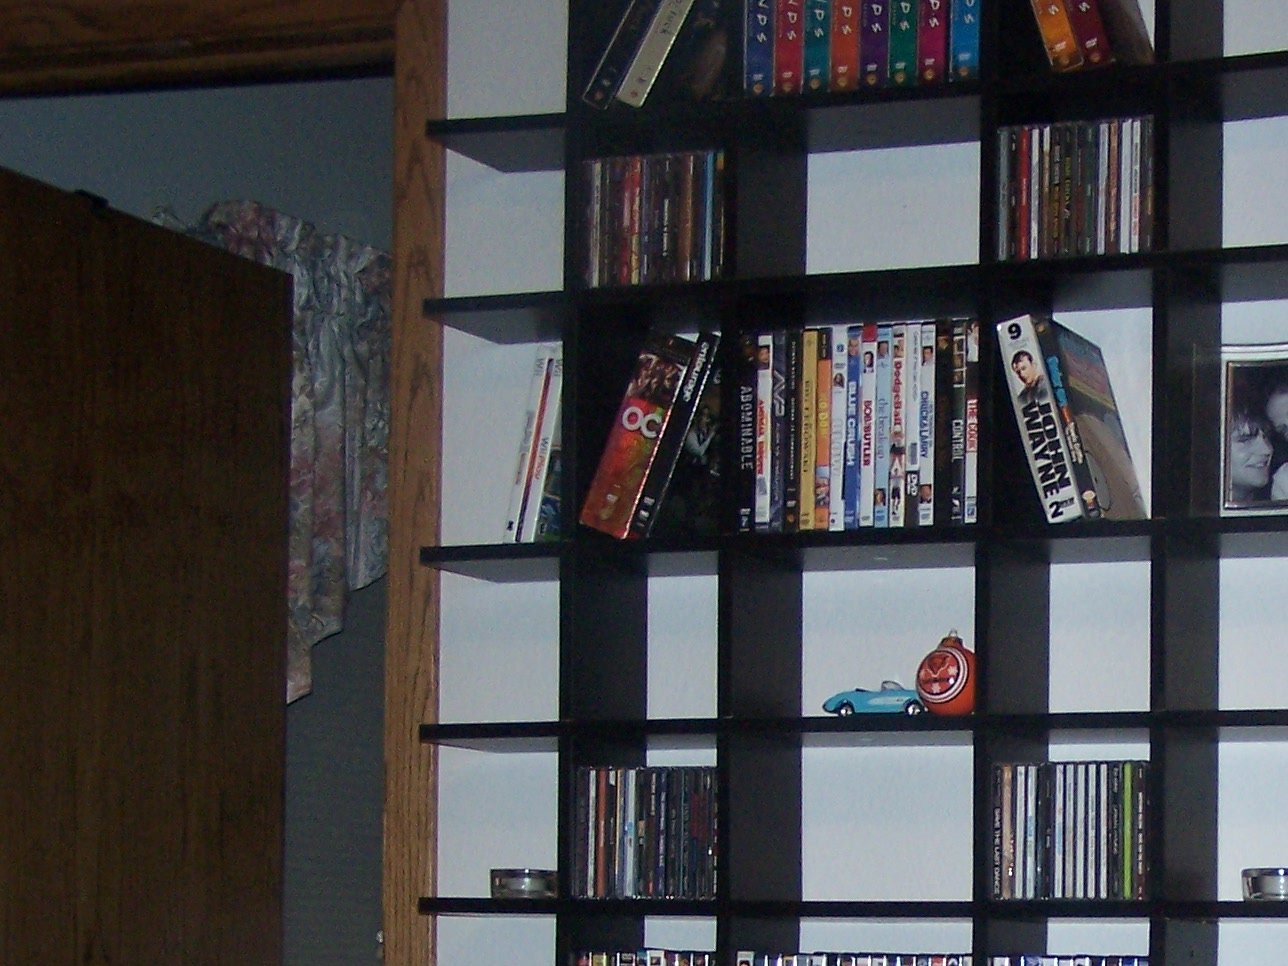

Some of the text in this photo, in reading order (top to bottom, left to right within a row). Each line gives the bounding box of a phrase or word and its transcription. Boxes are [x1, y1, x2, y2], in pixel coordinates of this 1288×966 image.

[1008, 323, 1022, 340] 9
[683, 342, 709, 403] entourage
[773, 369, 785, 417] AVP
[892, 361, 902, 426] DodgeBall
[621, 405, 664, 440] OC
[741, 386, 753, 471] ABOMINABLE
[846, 381, 856, 467] BLUE CRUSH
[920, 391, 929, 422] CHUCK
[968, 401, 978, 449] THE COOK
[919, 430, 928, 458] LARRY
[951, 419, 963, 463] CONTROL
[1022, 400, 1059, 499] WAYNE
[1038, 401, 1072, 489] JOHN
[909, 473, 919, 497] DVD
